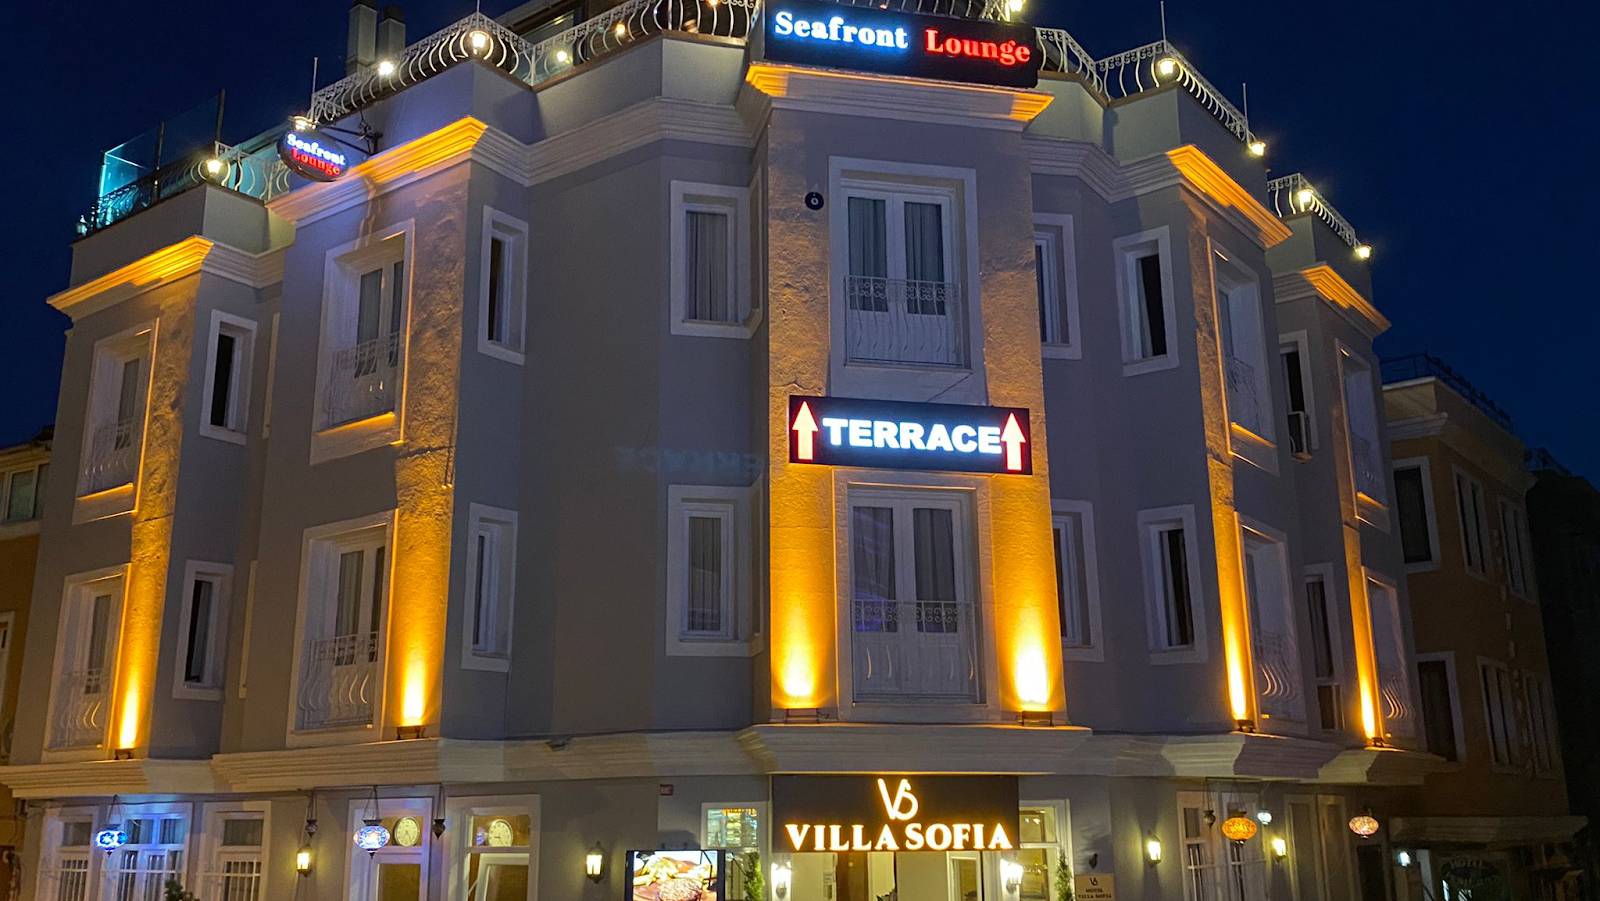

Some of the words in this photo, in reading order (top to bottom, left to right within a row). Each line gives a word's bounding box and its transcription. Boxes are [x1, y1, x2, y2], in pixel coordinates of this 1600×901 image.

[774, 12, 909, 49] Seafront
[925, 28, 1031, 66] Lounge
[287, 133, 346, 165] Seafront
[291, 147, 341, 176] Lounge
[822, 417, 1002, 454] TERRACE
[785, 824, 900, 850] VILLA
[905, 823, 1013, 850] SOFIA
